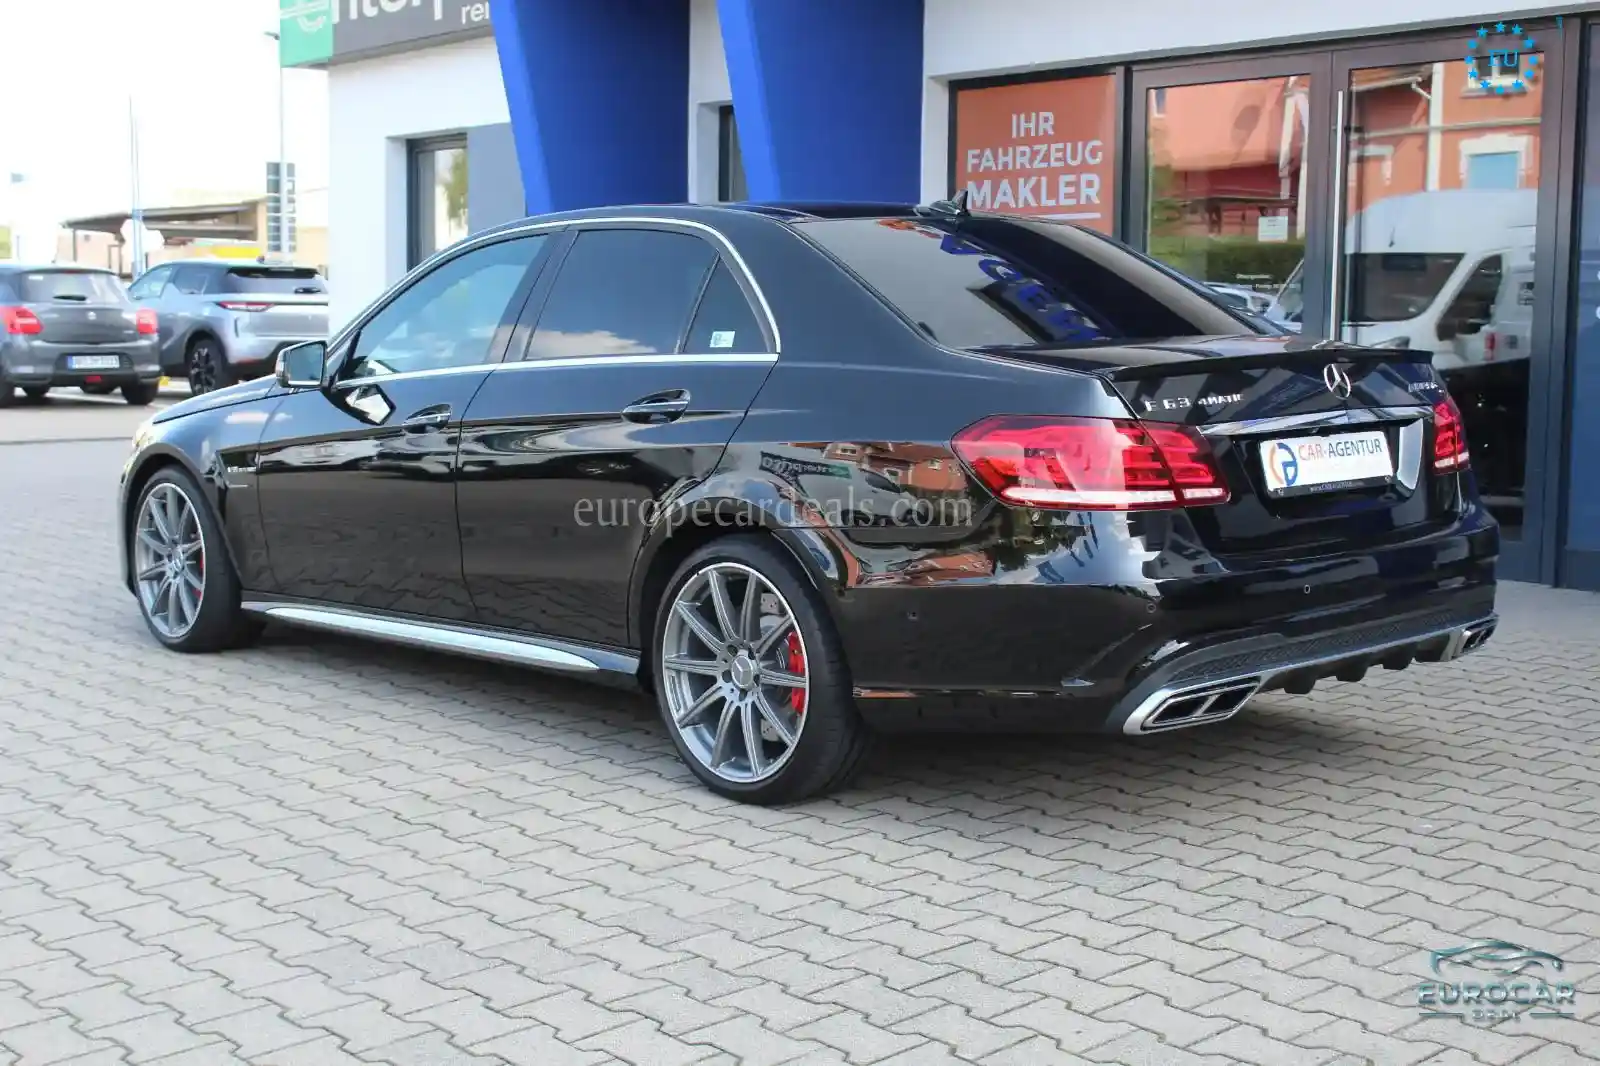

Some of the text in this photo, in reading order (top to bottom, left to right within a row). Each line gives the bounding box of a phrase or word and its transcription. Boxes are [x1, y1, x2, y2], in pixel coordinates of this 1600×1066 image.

[1011, 112, 1055, 139] IHR
[966, 139, 1104, 173] FAHRZEUG
[966, 173, 1101, 210] MAKLER
[1144, 399, 1157, 412] E
[1162, 397, 1192, 410] 63
